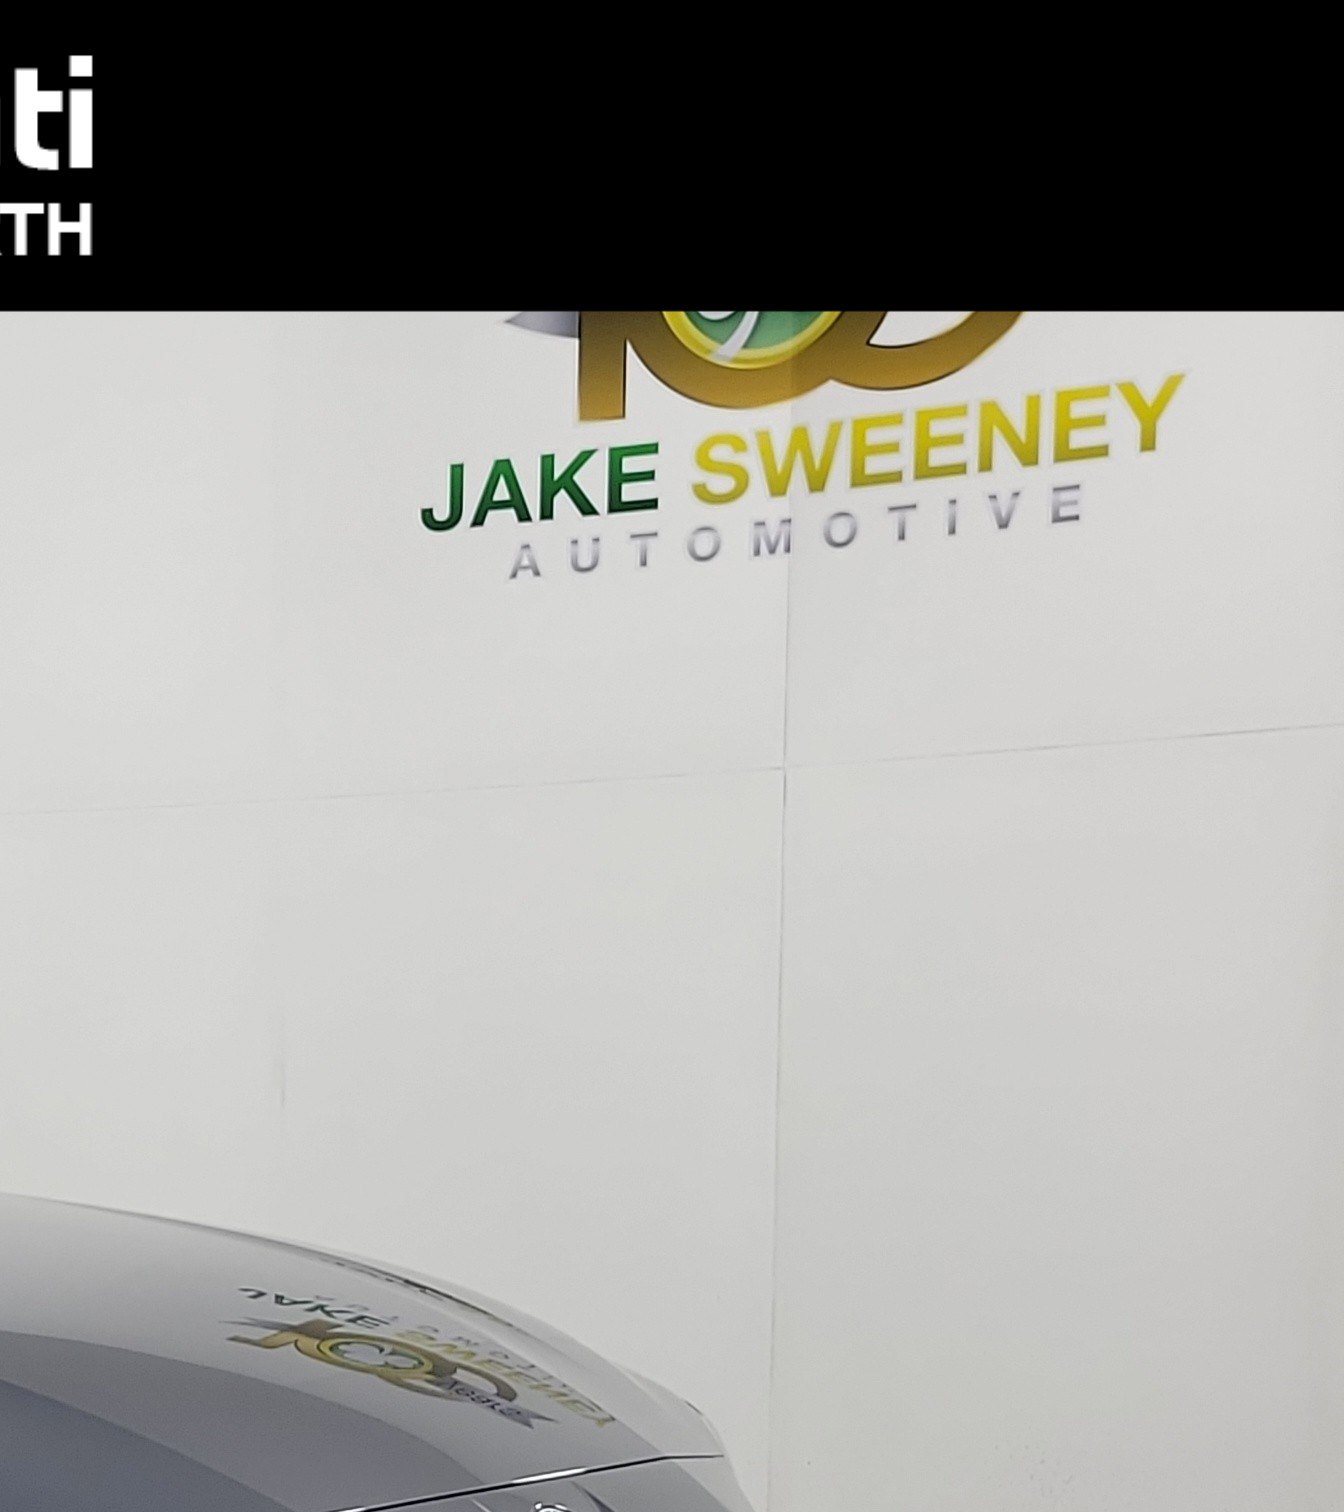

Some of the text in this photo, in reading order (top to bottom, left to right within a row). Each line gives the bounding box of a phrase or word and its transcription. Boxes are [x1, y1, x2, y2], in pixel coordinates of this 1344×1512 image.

[420, 373, 1185, 531] JAKE SWEENEY
[508, 484, 1082, 580] AUTOMOTIVE
